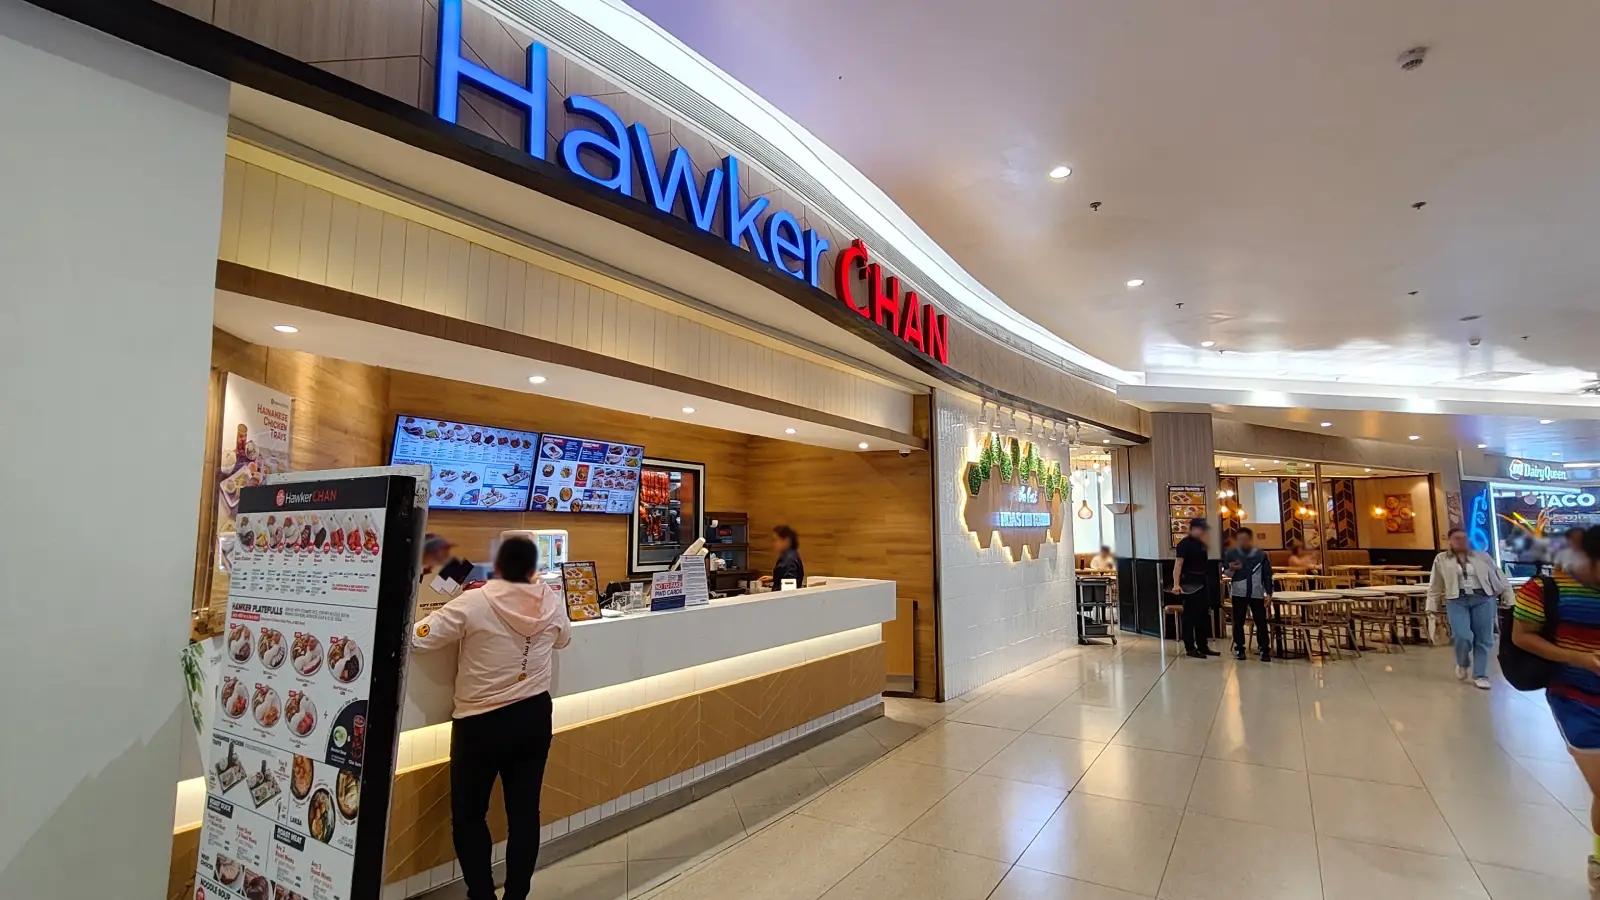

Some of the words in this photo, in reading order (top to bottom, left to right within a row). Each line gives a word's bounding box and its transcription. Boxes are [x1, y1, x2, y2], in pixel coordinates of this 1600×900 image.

[436, 0, 830, 290] Hawker
[835, 238, 949, 365] CHAN
[257, 403, 289, 422] HAINANESE
[263, 416, 288, 431] CHICKEN
[270, 428, 287, 441] TRAYS
[1523, 463, 1545, 481] Dairy
[1544, 466, 1567, 480] Queen
[285, 491, 312, 504] Hawker
[312, 489, 337, 501] CHAN
[1537, 493, 1596, 508] TACO
[667, 588, 683, 596] CARDS
[231, 602, 251, 611] HAWKER
